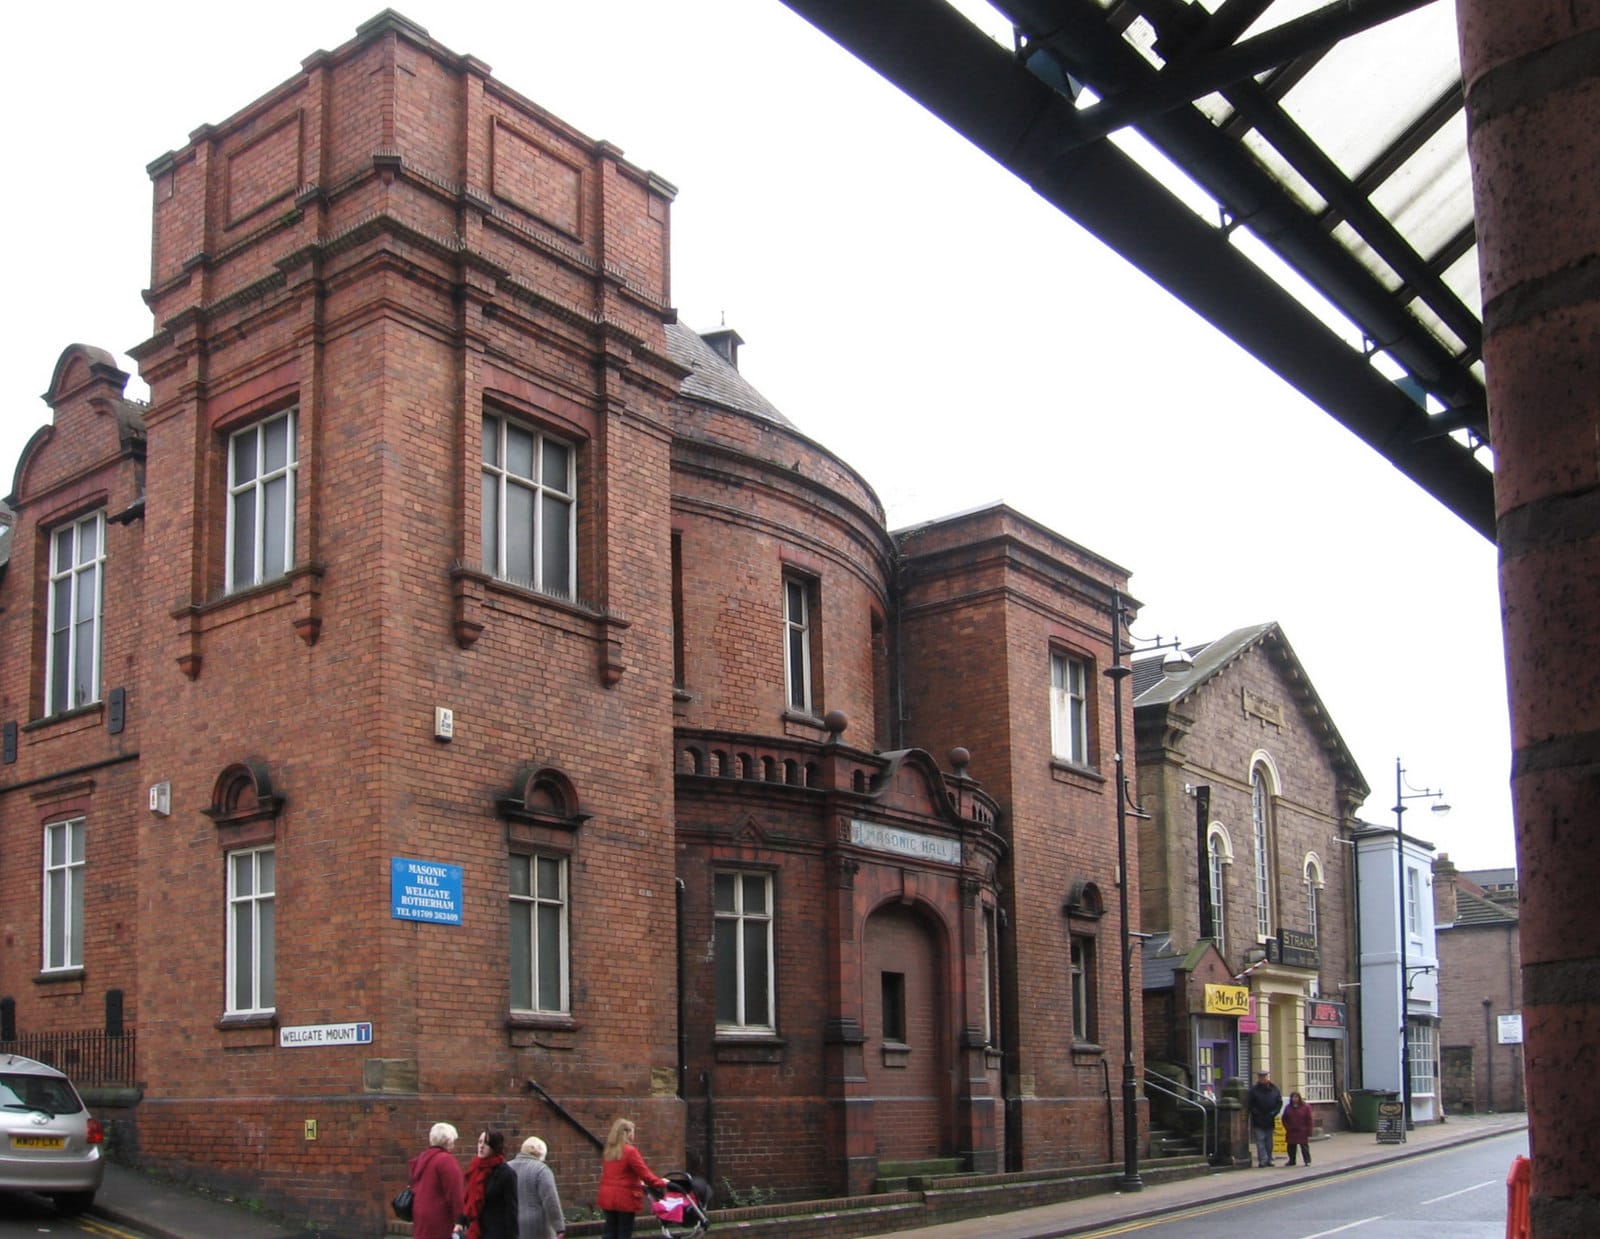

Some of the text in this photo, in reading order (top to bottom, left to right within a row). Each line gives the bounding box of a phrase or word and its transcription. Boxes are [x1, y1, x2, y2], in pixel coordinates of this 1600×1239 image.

[866, 829, 947, 856] MASONIC HALL
[408, 863, 448, 878] MASONIC
[416, 874, 440, 887] HALL
[405, 885, 451, 900] WELLGATE
[401, 895, 454, 910] ROTHERHAM
[396, 907, 411, 917] TEL
[411, 909, 434, 919] 01709
[1283, 931, 1316, 949] STRAND
[282, 1027, 355, 1042] WELLGATE MOUNT
